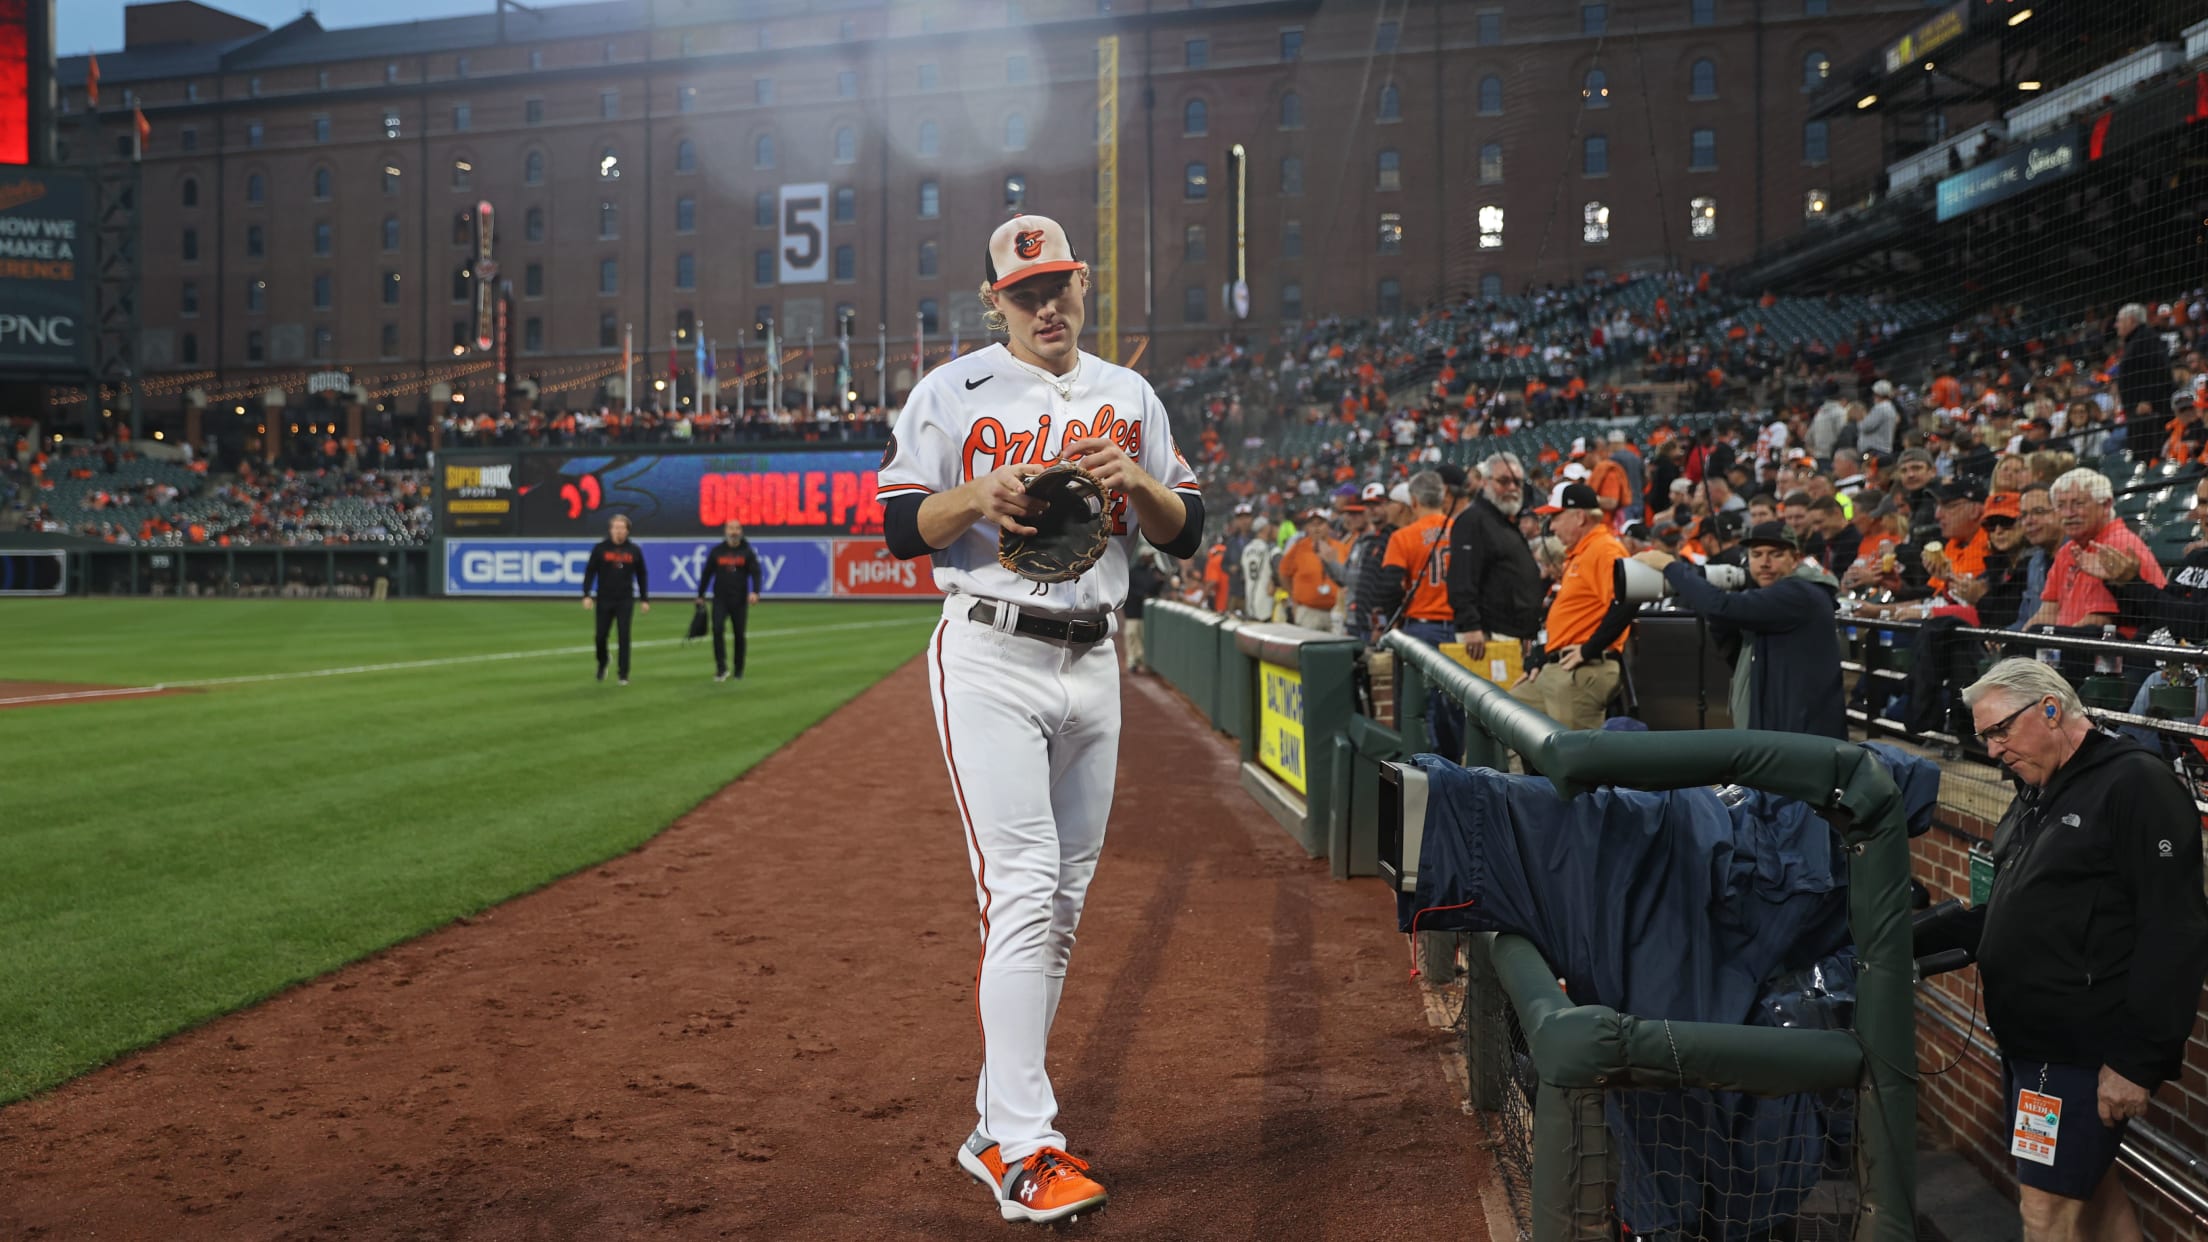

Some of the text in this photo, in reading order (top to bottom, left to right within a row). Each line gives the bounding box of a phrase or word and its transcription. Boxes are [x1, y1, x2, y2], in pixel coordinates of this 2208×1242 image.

[42, 219, 77, 240] WE
[58, 240, 74, 260] A
[783, 196, 822, 270] 5
[0, 313, 75, 347] PNC
[962, 403, 1142, 483] Orioles
[699, 472, 828, 526] ORIOLE
[849, 560, 917, 588] HIGH'S
[1279, 727, 1303, 779] BANK
